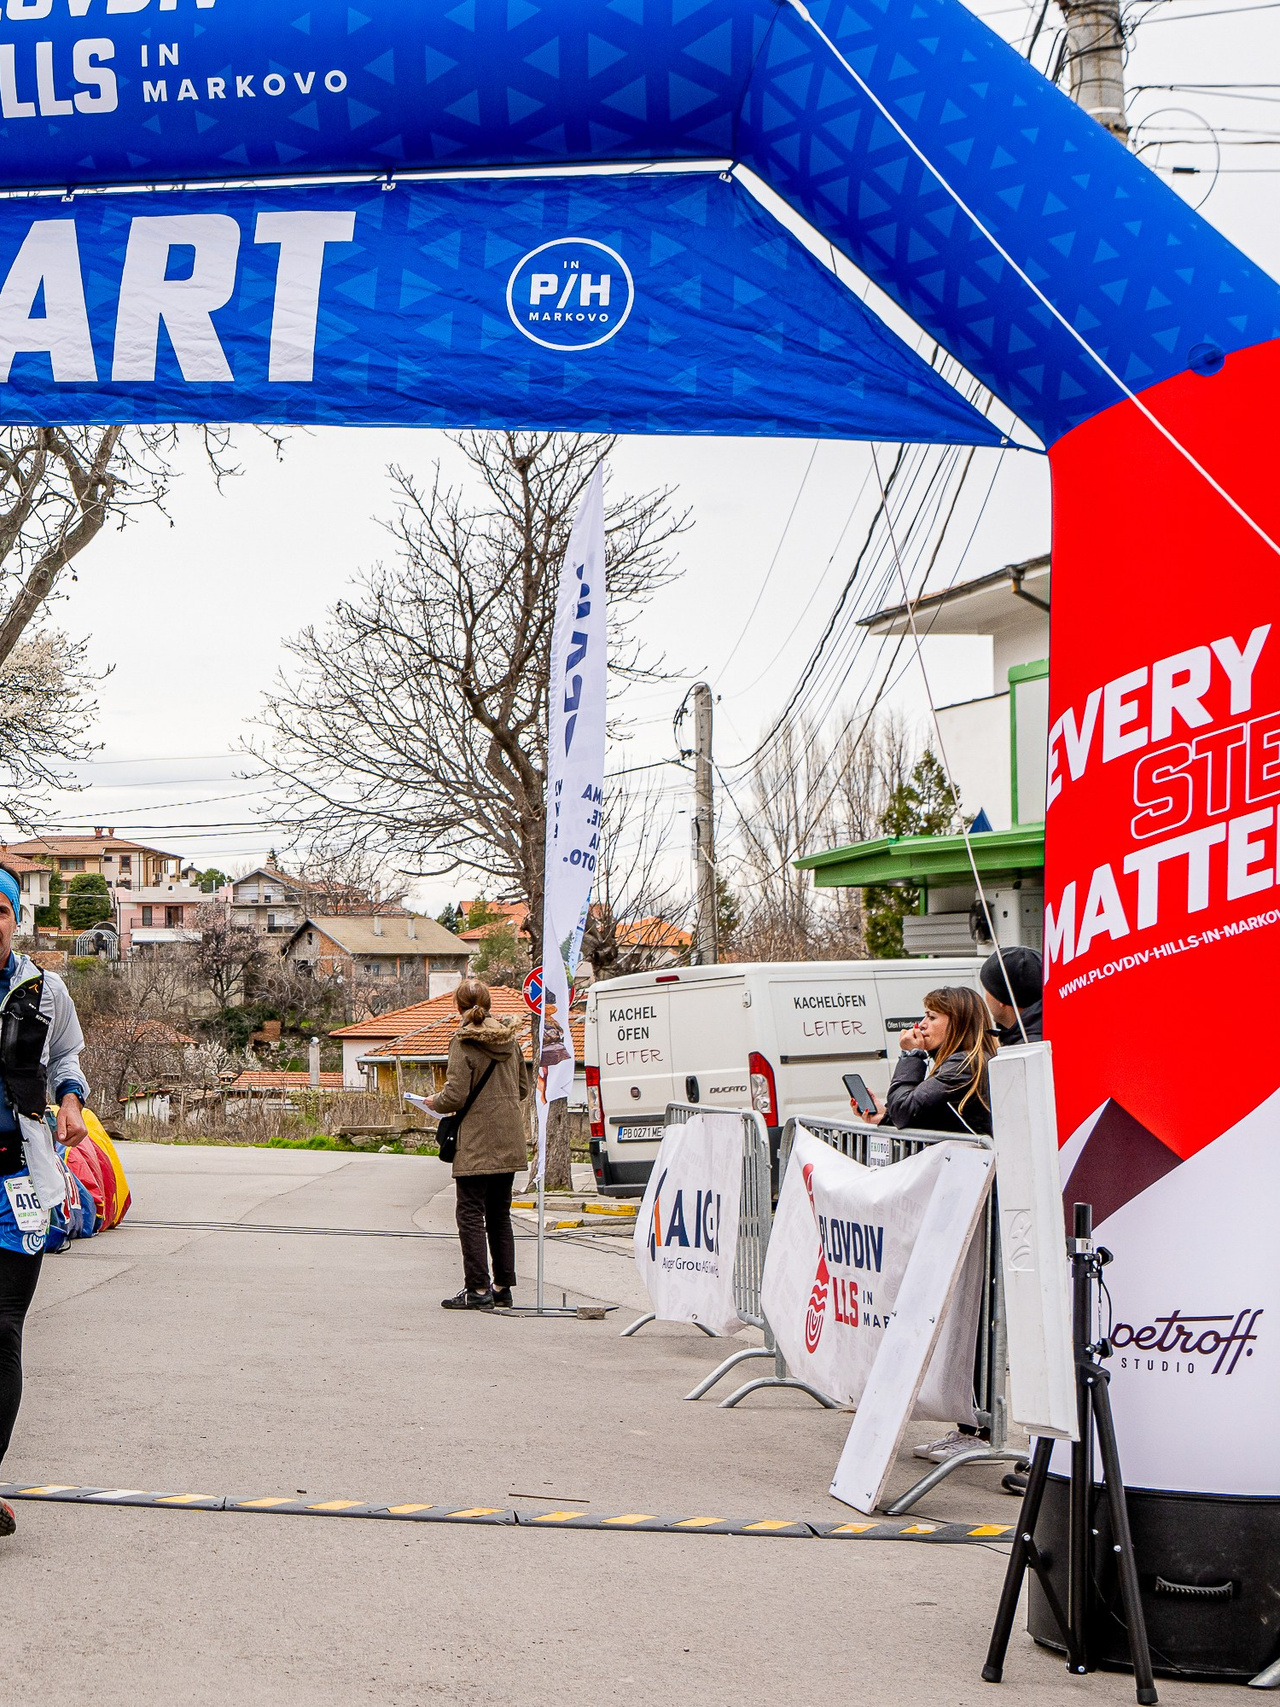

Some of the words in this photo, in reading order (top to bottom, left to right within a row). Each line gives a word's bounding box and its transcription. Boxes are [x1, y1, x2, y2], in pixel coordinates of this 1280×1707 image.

[141, 43, 180, 67] IN
[141, 69, 348, 103] MARKOVO
[563, 260, 580, 269] IN
[529, 273, 611, 309] P/H
[529, 312, 609, 322] MARKOVO
[1046, 623, 1272, 812] EVERY
[1130, 710, 1280, 840] STE
[1044, 804, 1280, 986] MATTE
[793, 992, 866, 1010] KACHELÖFEN
[609, 1005, 657, 1023] KACHEL
[617, 1025, 650, 1042] ÖFEN
[802, 1020, 867, 1038] LEITER
[605, 1049, 664, 1066] LEITER
[709, 1085, 747, 1094] DUCATO
[622, 1128, 632, 1138] PB
[633, 1127, 651, 1138] 0271
[651, 1126, 662, 1137] ME
[15, 1192, 42, 1210] 416
[818, 1214, 884, 1273] PLOVDIV
[675, 1257, 701, 1272] Grou
[832, 1276, 859, 1328] LLS
[862, 1289, 874, 1306] IN
[1120, 1357, 1195, 1374] STUDIO
